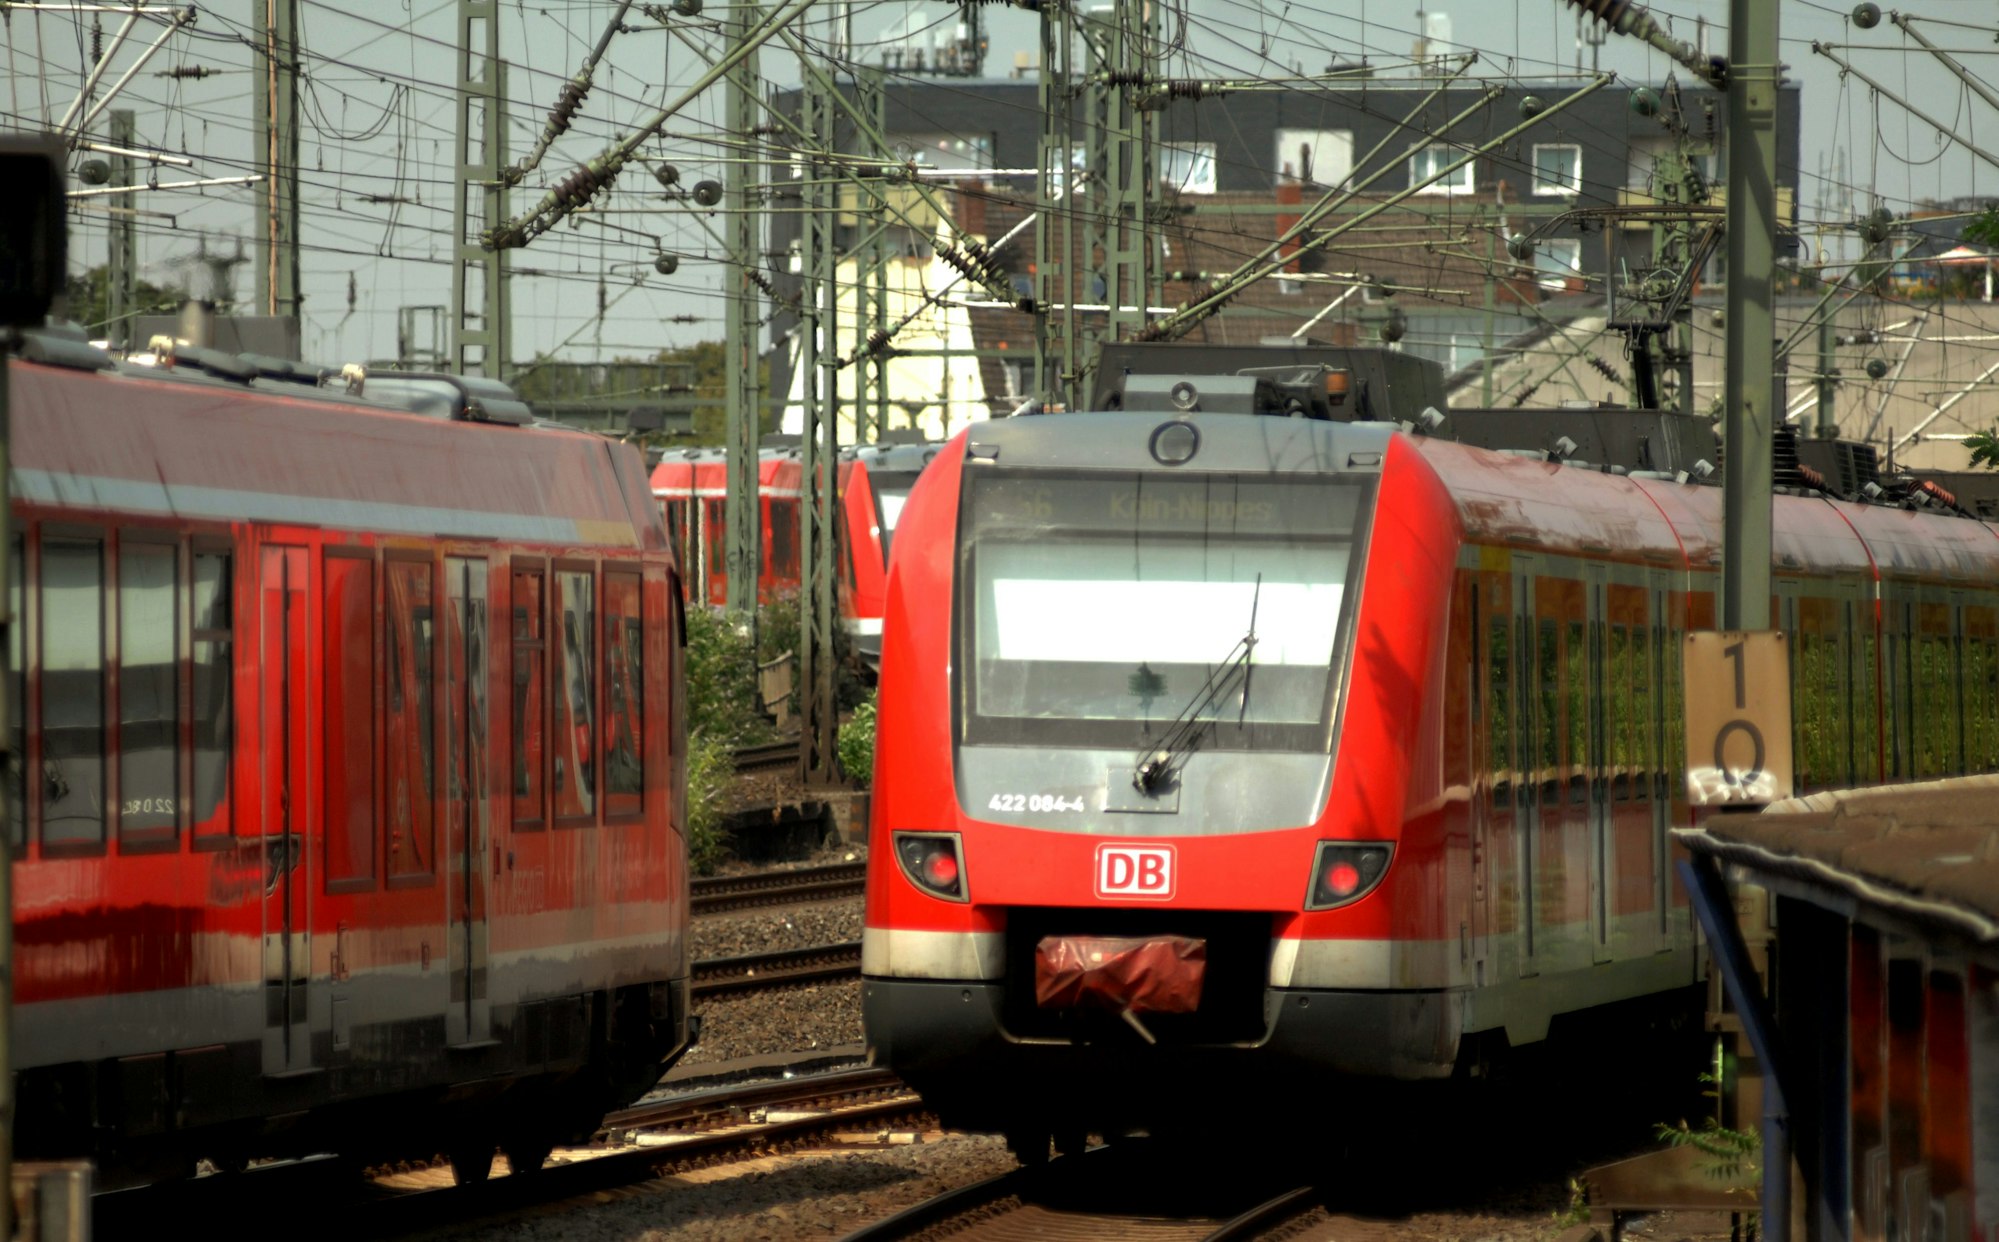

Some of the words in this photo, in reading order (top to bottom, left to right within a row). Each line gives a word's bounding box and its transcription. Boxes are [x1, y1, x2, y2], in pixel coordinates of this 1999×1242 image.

[988, 793, 1026, 812] 422
[1029, 794, 1085, 813] 084-4
[1105, 852, 1166, 891] DB
